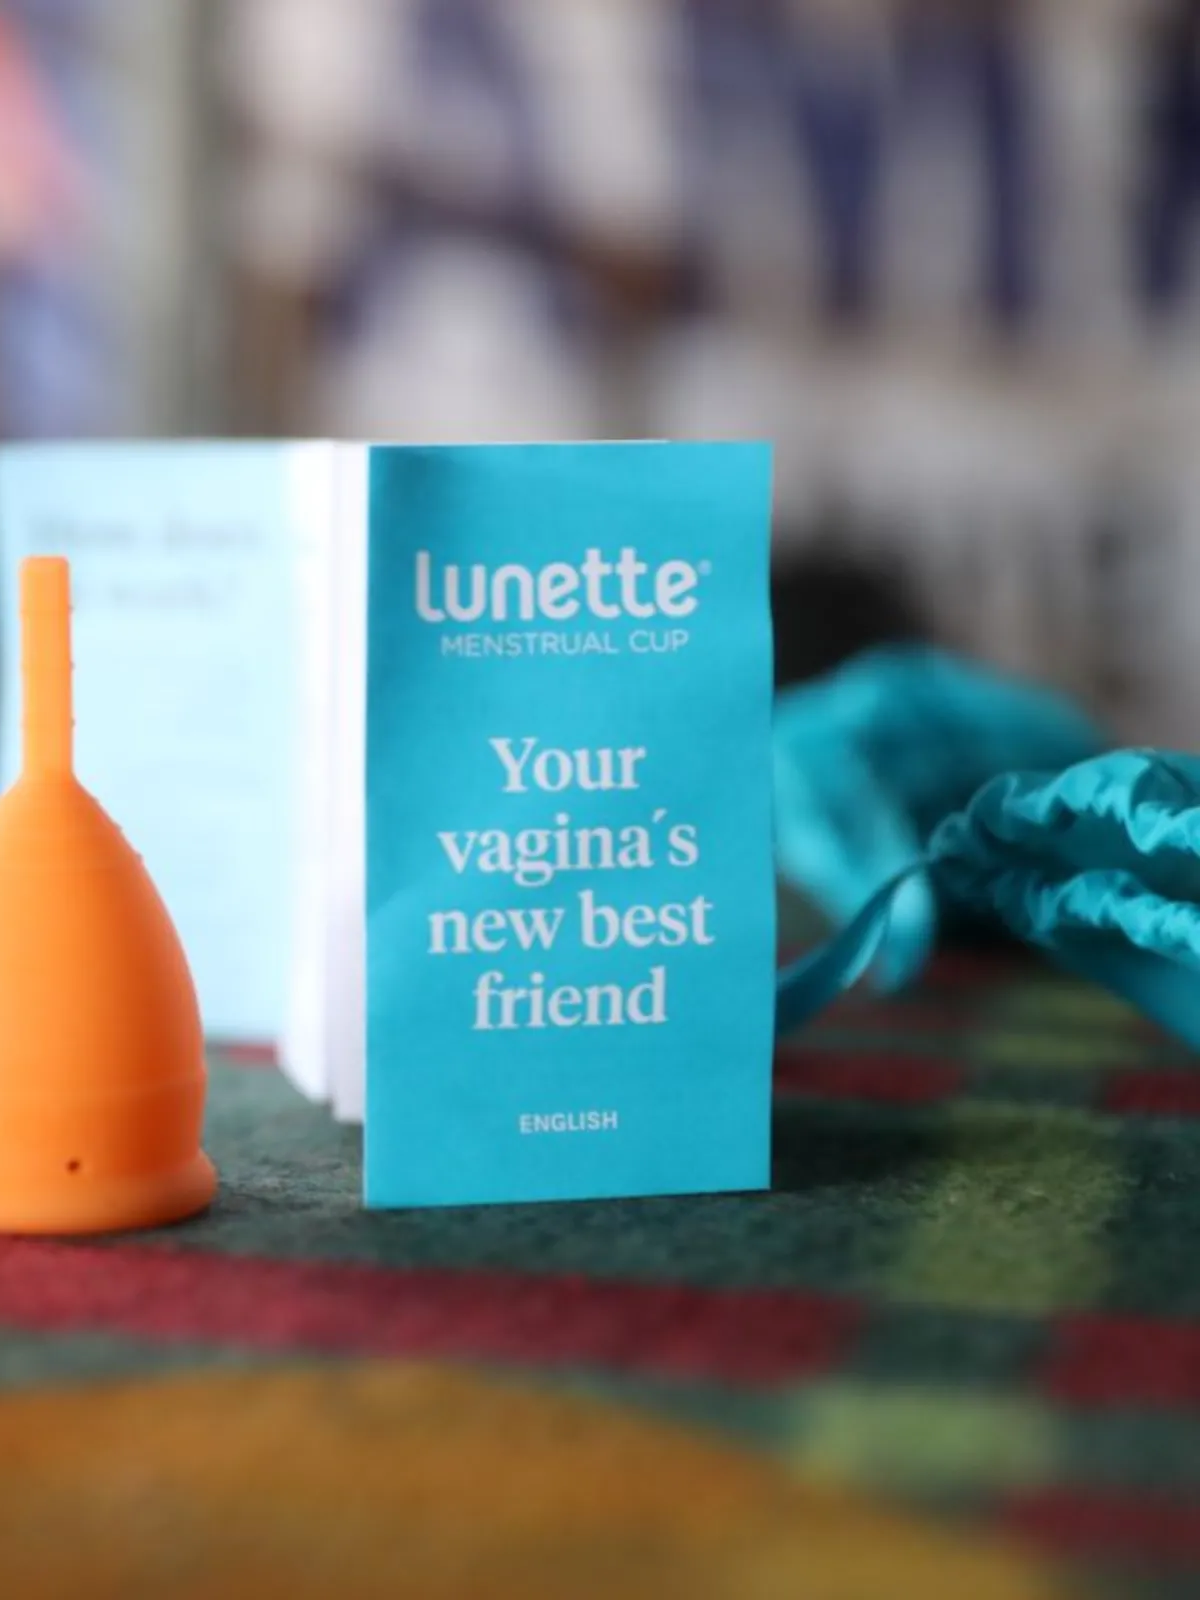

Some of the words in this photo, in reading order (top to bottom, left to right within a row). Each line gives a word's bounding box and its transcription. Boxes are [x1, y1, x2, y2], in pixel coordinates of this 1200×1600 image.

[441, 633, 619, 657] MENSTRUAL
[628, 629, 689, 653] CUP
[488, 736, 648, 793] Your
[427, 907, 566, 954] new
[578, 889, 715, 949] best
[472, 965, 668, 1030] friend
[519, 1111, 619, 1135] ENGLISH
